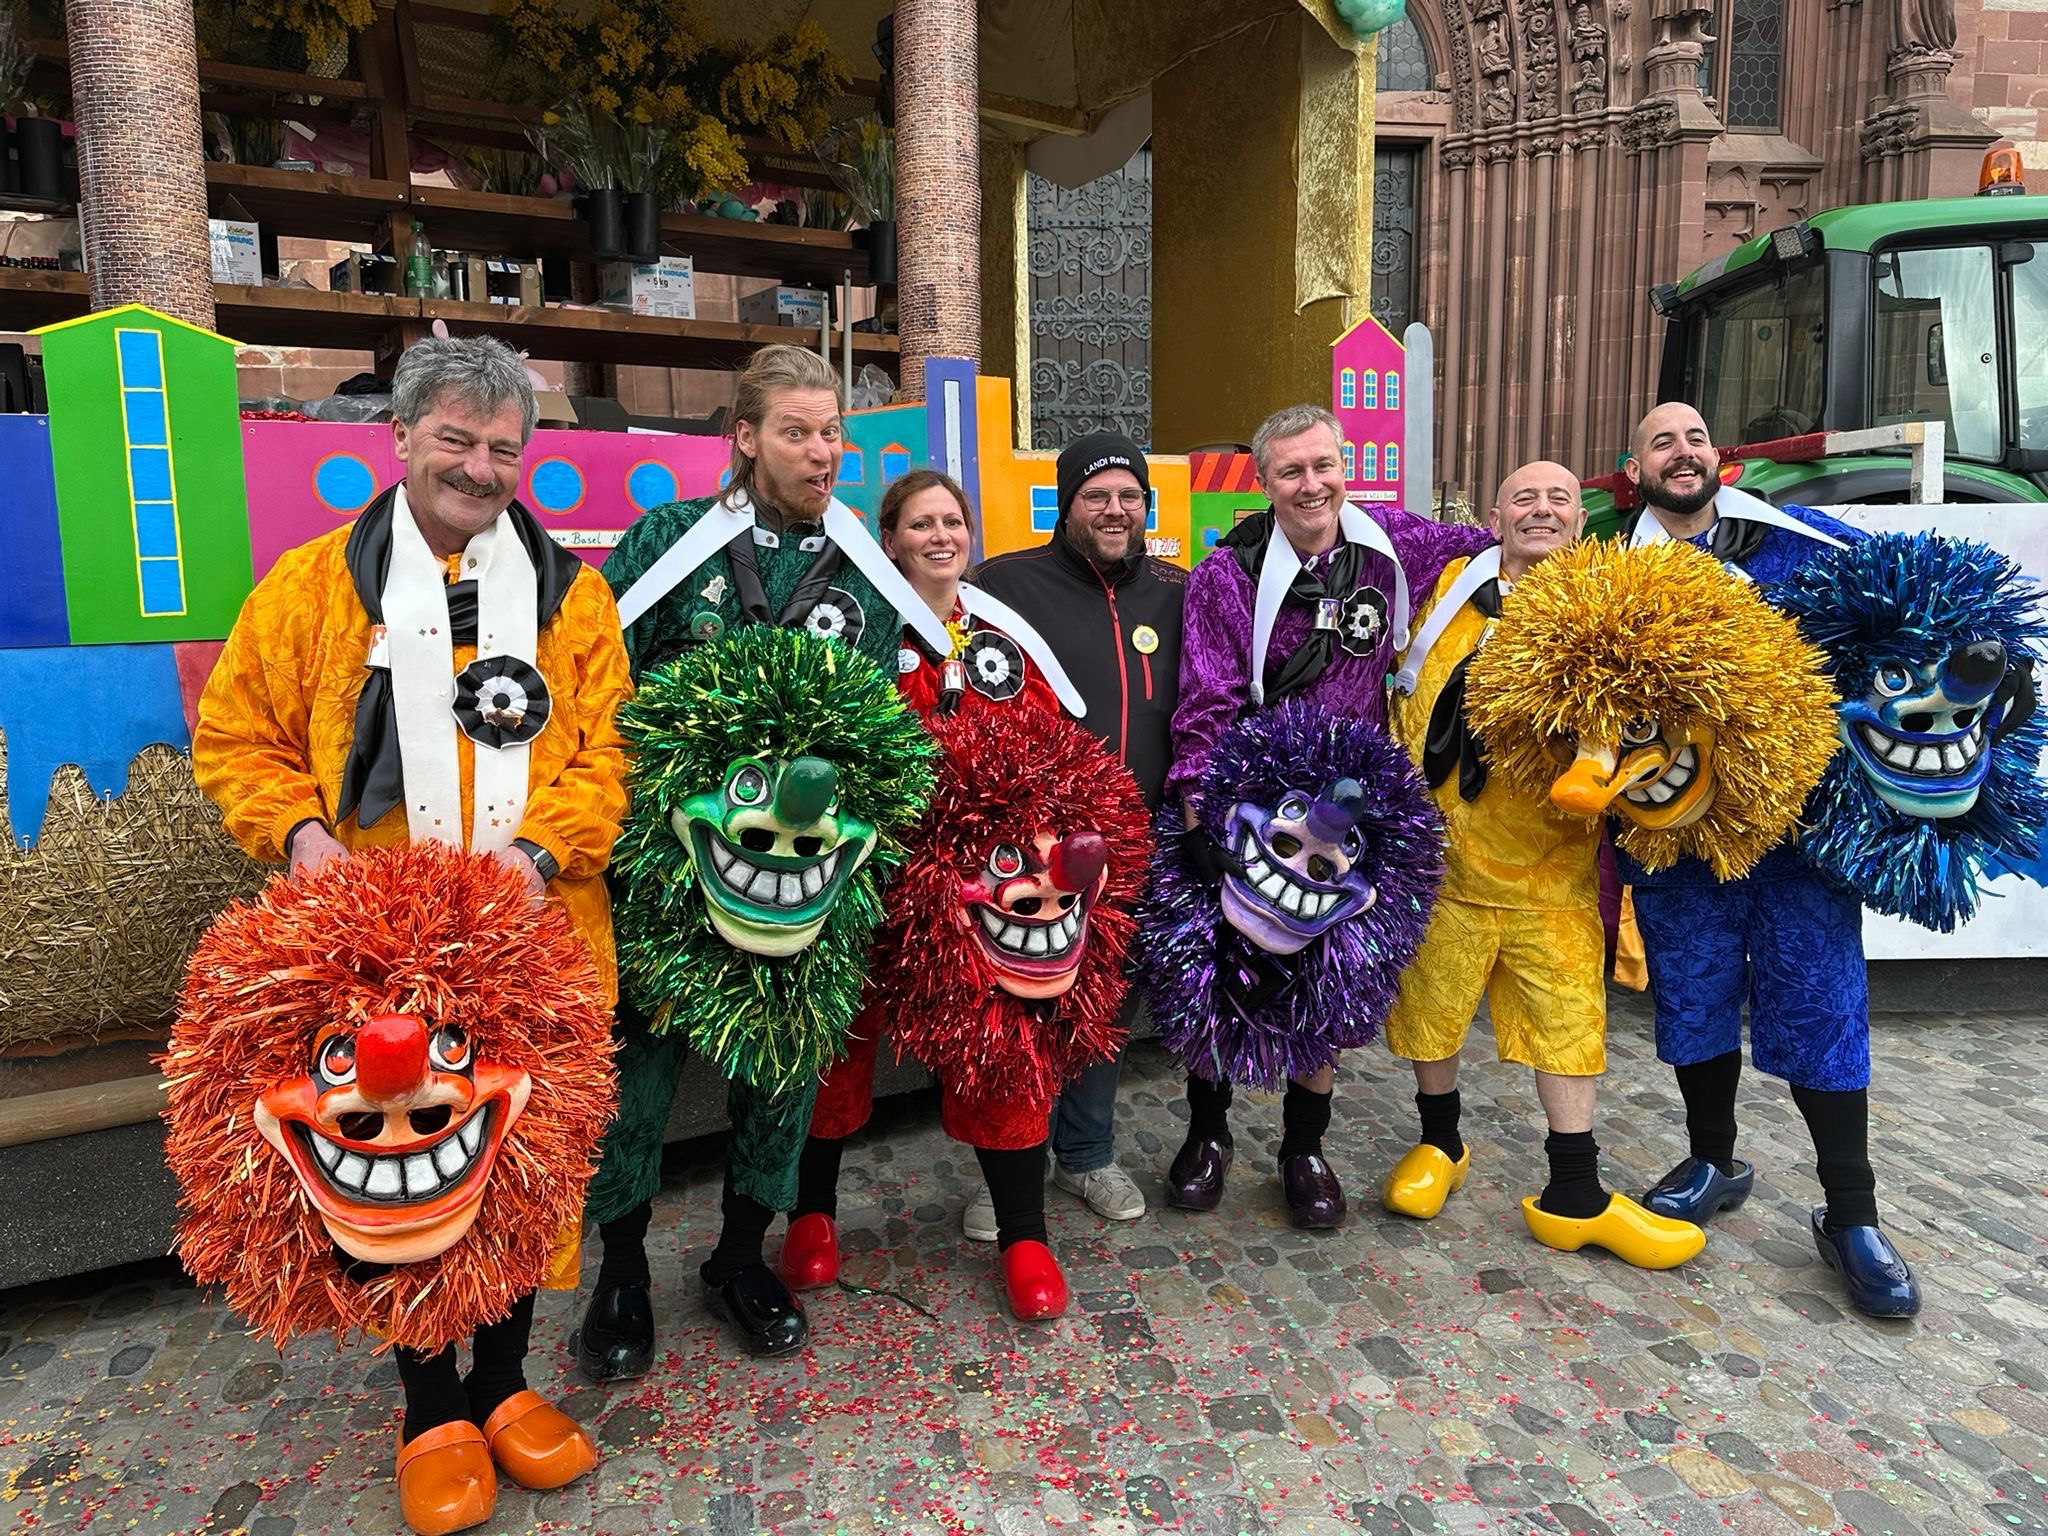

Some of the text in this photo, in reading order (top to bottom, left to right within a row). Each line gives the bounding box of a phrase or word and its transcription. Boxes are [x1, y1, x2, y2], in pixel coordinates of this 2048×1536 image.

[1083, 456, 1130, 476] LANDI Reba
[571, 531, 601, 545] Basel
